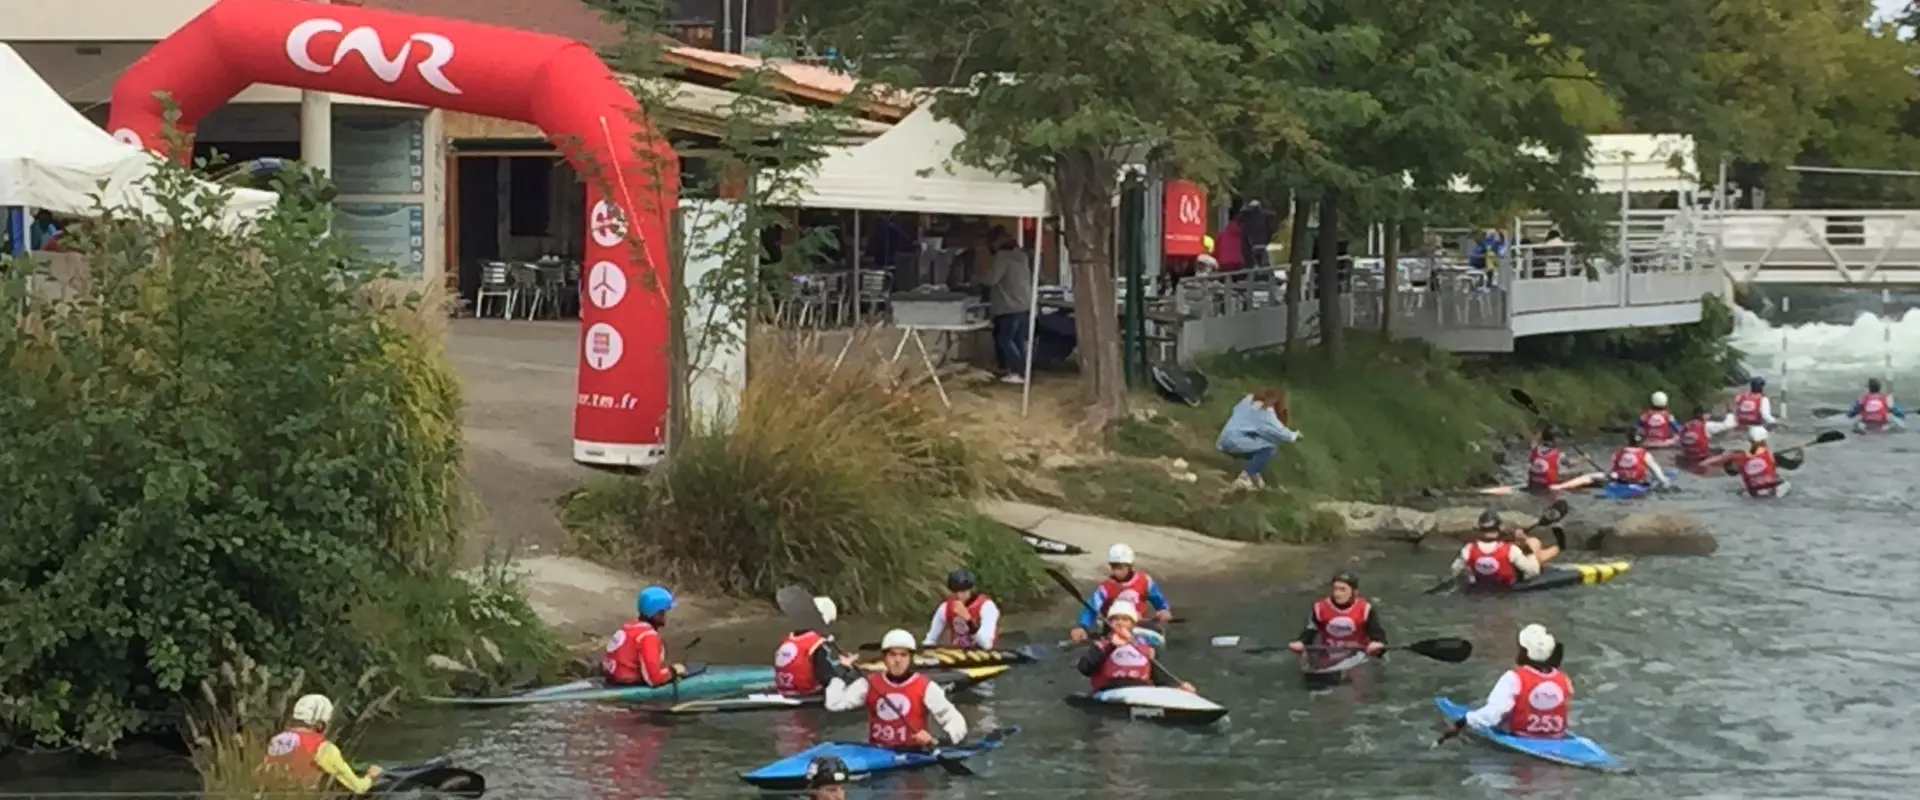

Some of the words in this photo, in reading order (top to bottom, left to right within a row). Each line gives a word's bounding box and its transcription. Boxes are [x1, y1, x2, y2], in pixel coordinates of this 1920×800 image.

[286, 18, 463, 95] CNR
[872, 723, 907, 742] 291
[1527, 714, 1564, 732] 253
